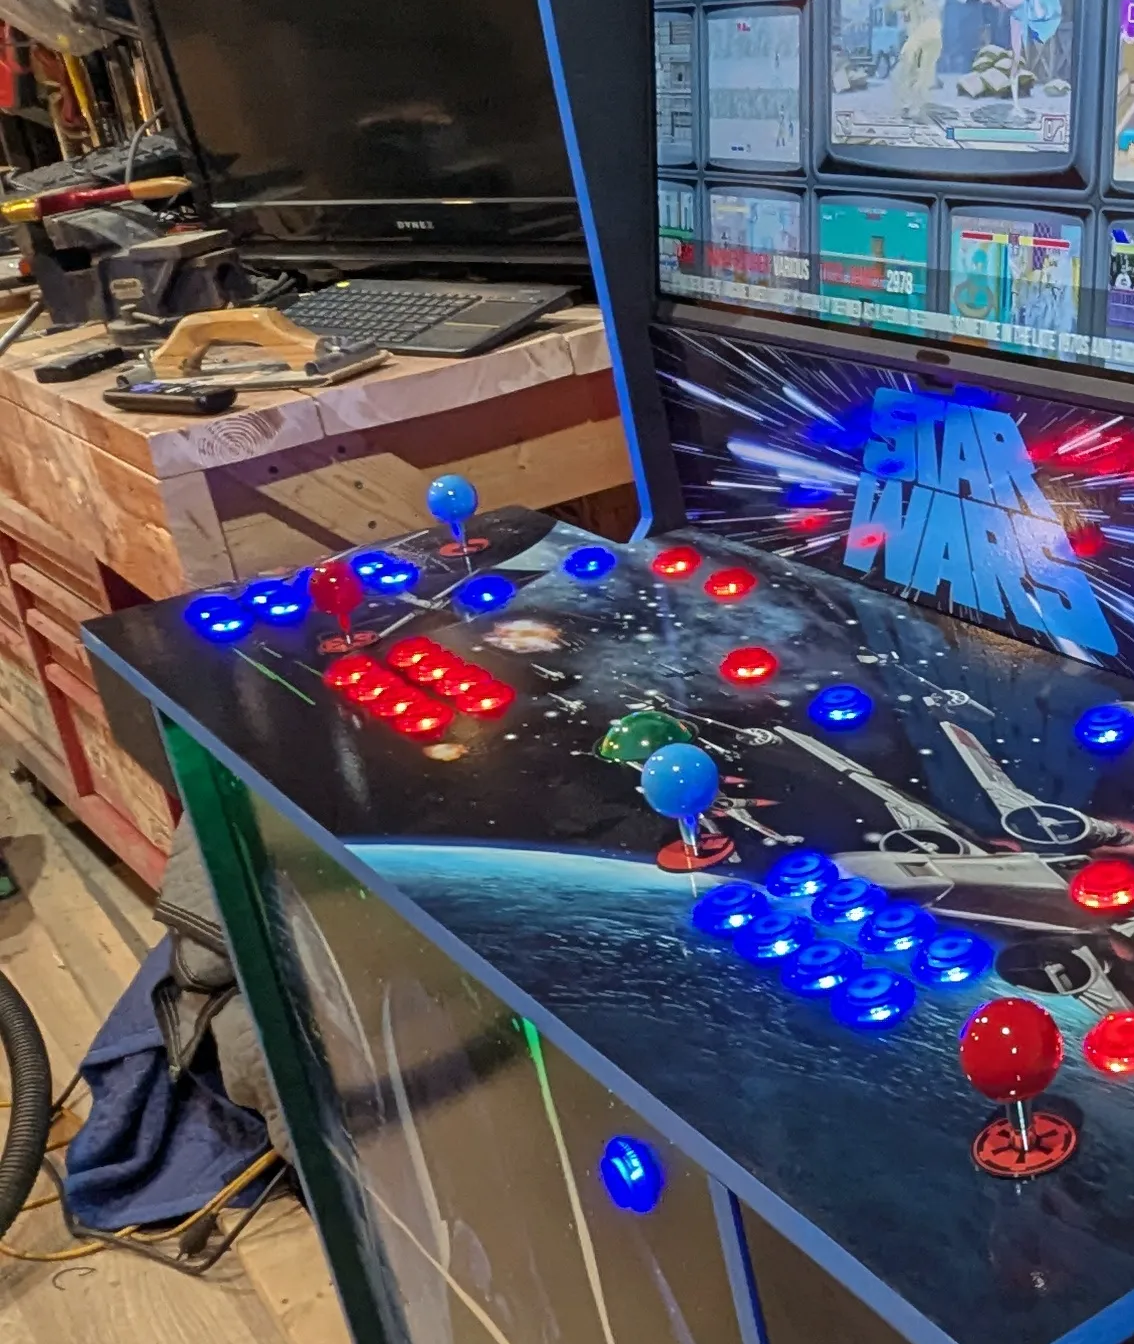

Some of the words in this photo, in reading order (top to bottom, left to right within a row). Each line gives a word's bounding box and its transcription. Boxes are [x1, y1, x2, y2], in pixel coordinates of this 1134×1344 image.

[773, 255, 809, 281] VARIOUS
[886, 269, 914, 295] 2978
[863, 387, 1062, 526] STAR
[843, 471, 1119, 657] WARS
